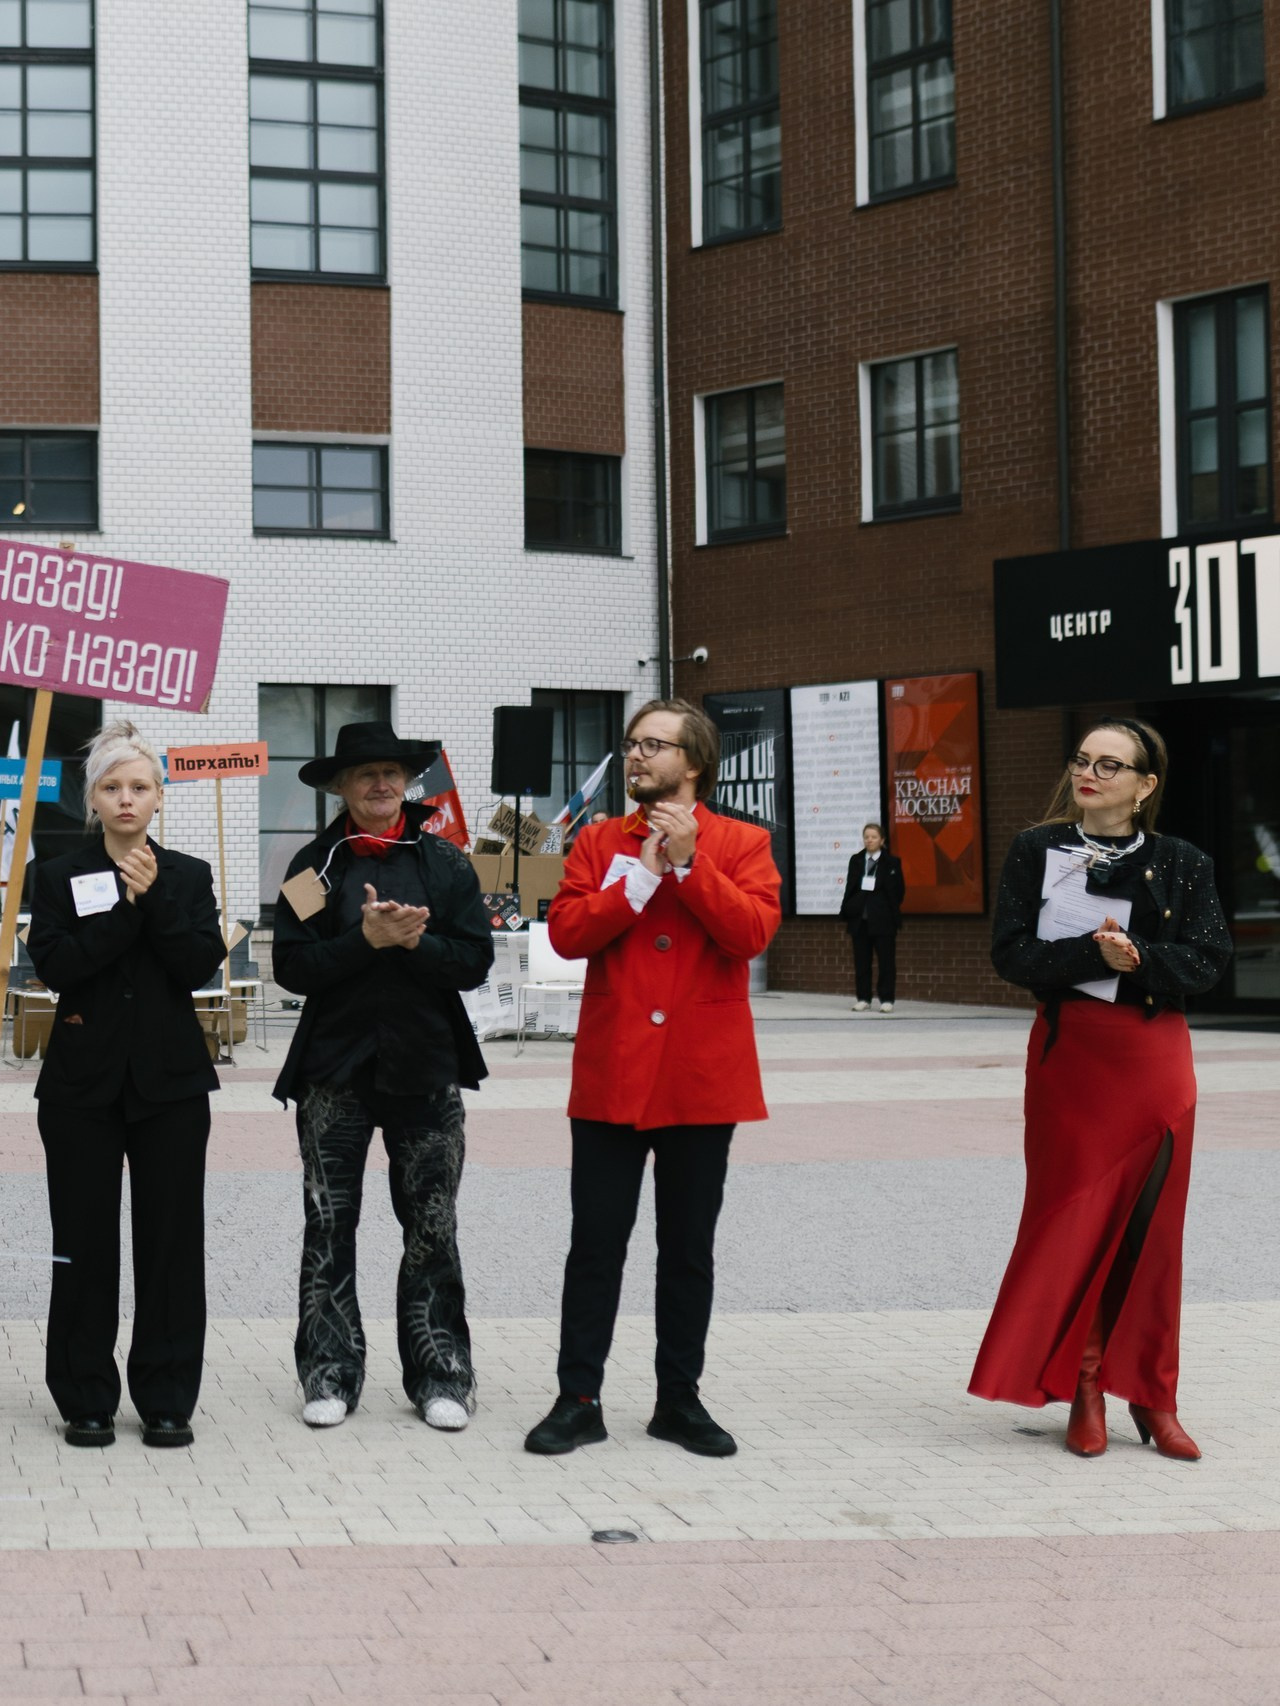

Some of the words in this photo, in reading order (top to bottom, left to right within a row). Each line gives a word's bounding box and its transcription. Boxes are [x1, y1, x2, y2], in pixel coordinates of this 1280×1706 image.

[1050, 609, 1111, 641] ЦЕНТР
[174, 753, 260, 772] Порхать!
[895, 777, 971, 798] КРАСНАЯ
[895, 797, 962, 816] МОСКВА
